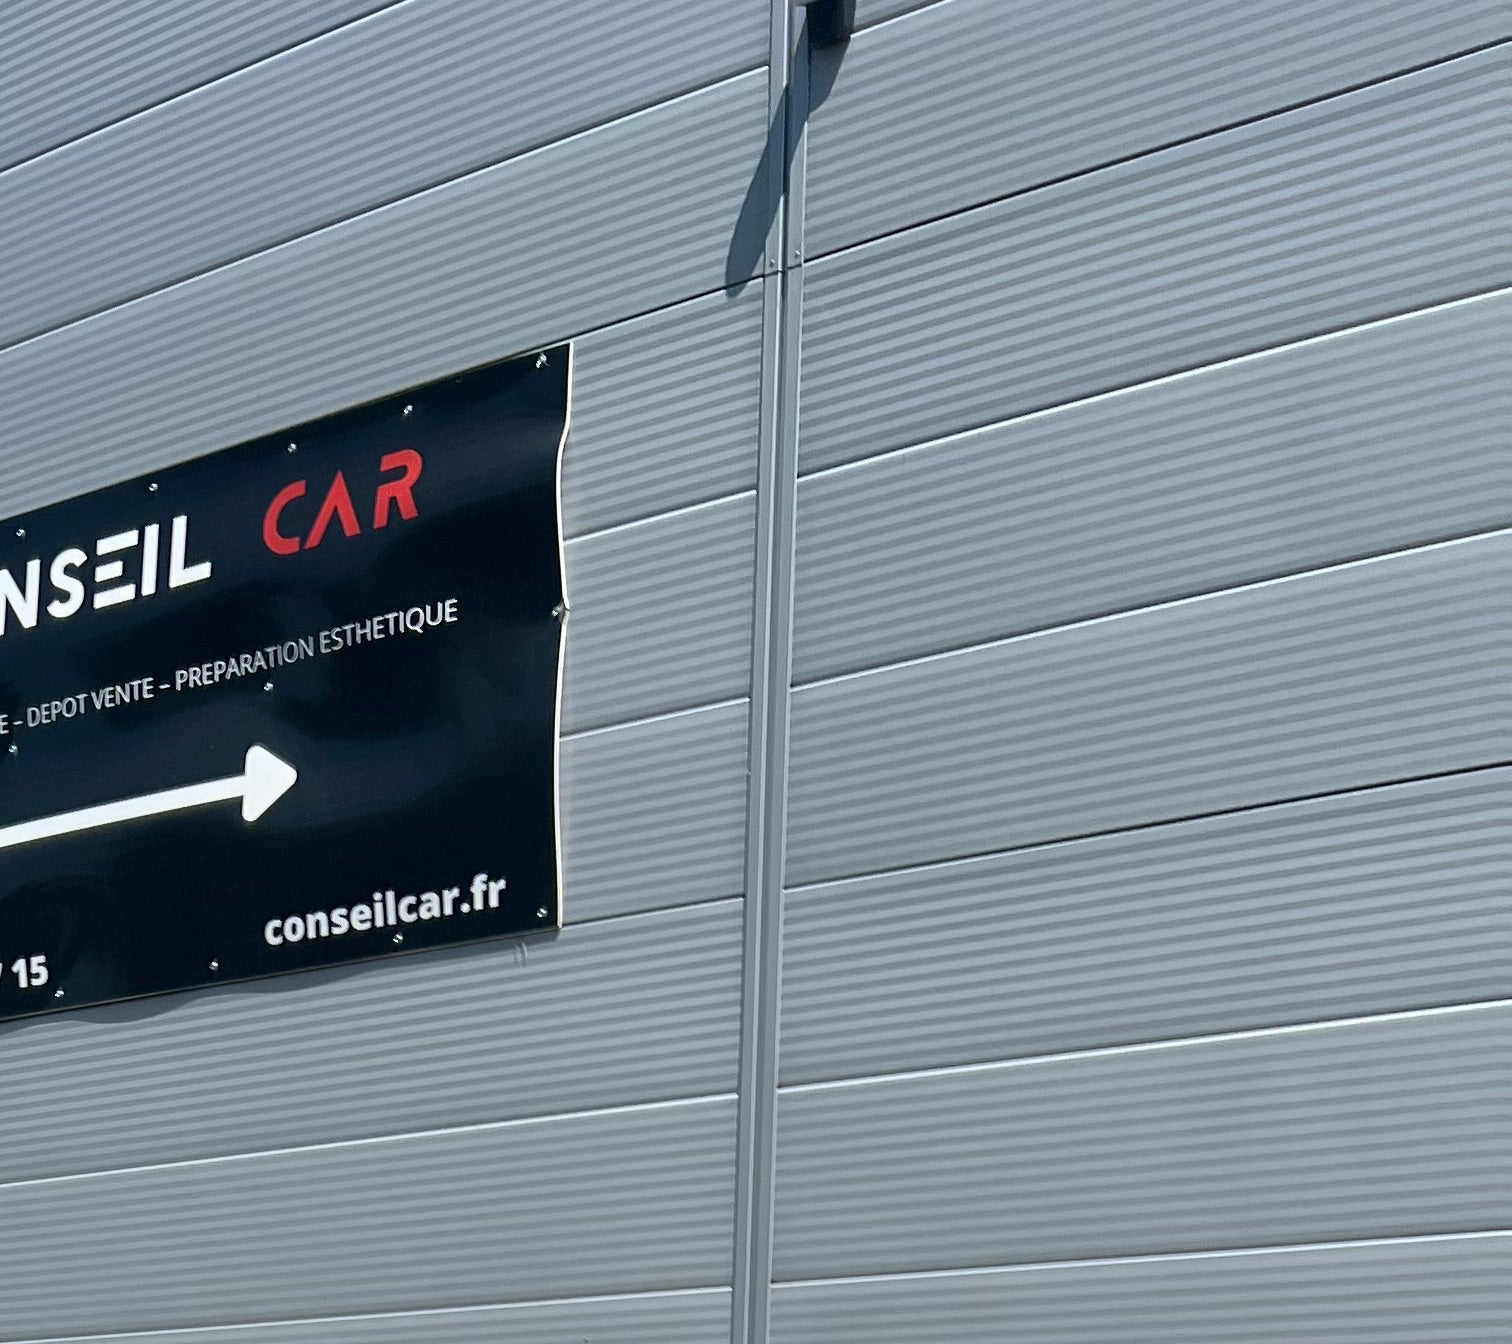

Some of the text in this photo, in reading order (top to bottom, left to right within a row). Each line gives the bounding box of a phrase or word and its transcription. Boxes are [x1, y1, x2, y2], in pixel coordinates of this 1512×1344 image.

[262, 448, 424, 556] CAR
[26, 693, 89, 728] DEPOT
[90, 677, 155, 711] VENTE
[174, 634, 315, 692] PREPARATION
[318, 597, 460, 655] ESTHETIQUE
[263, 873, 508, 947] conseilcar.fr
[10, 954, 50, 989] 15
